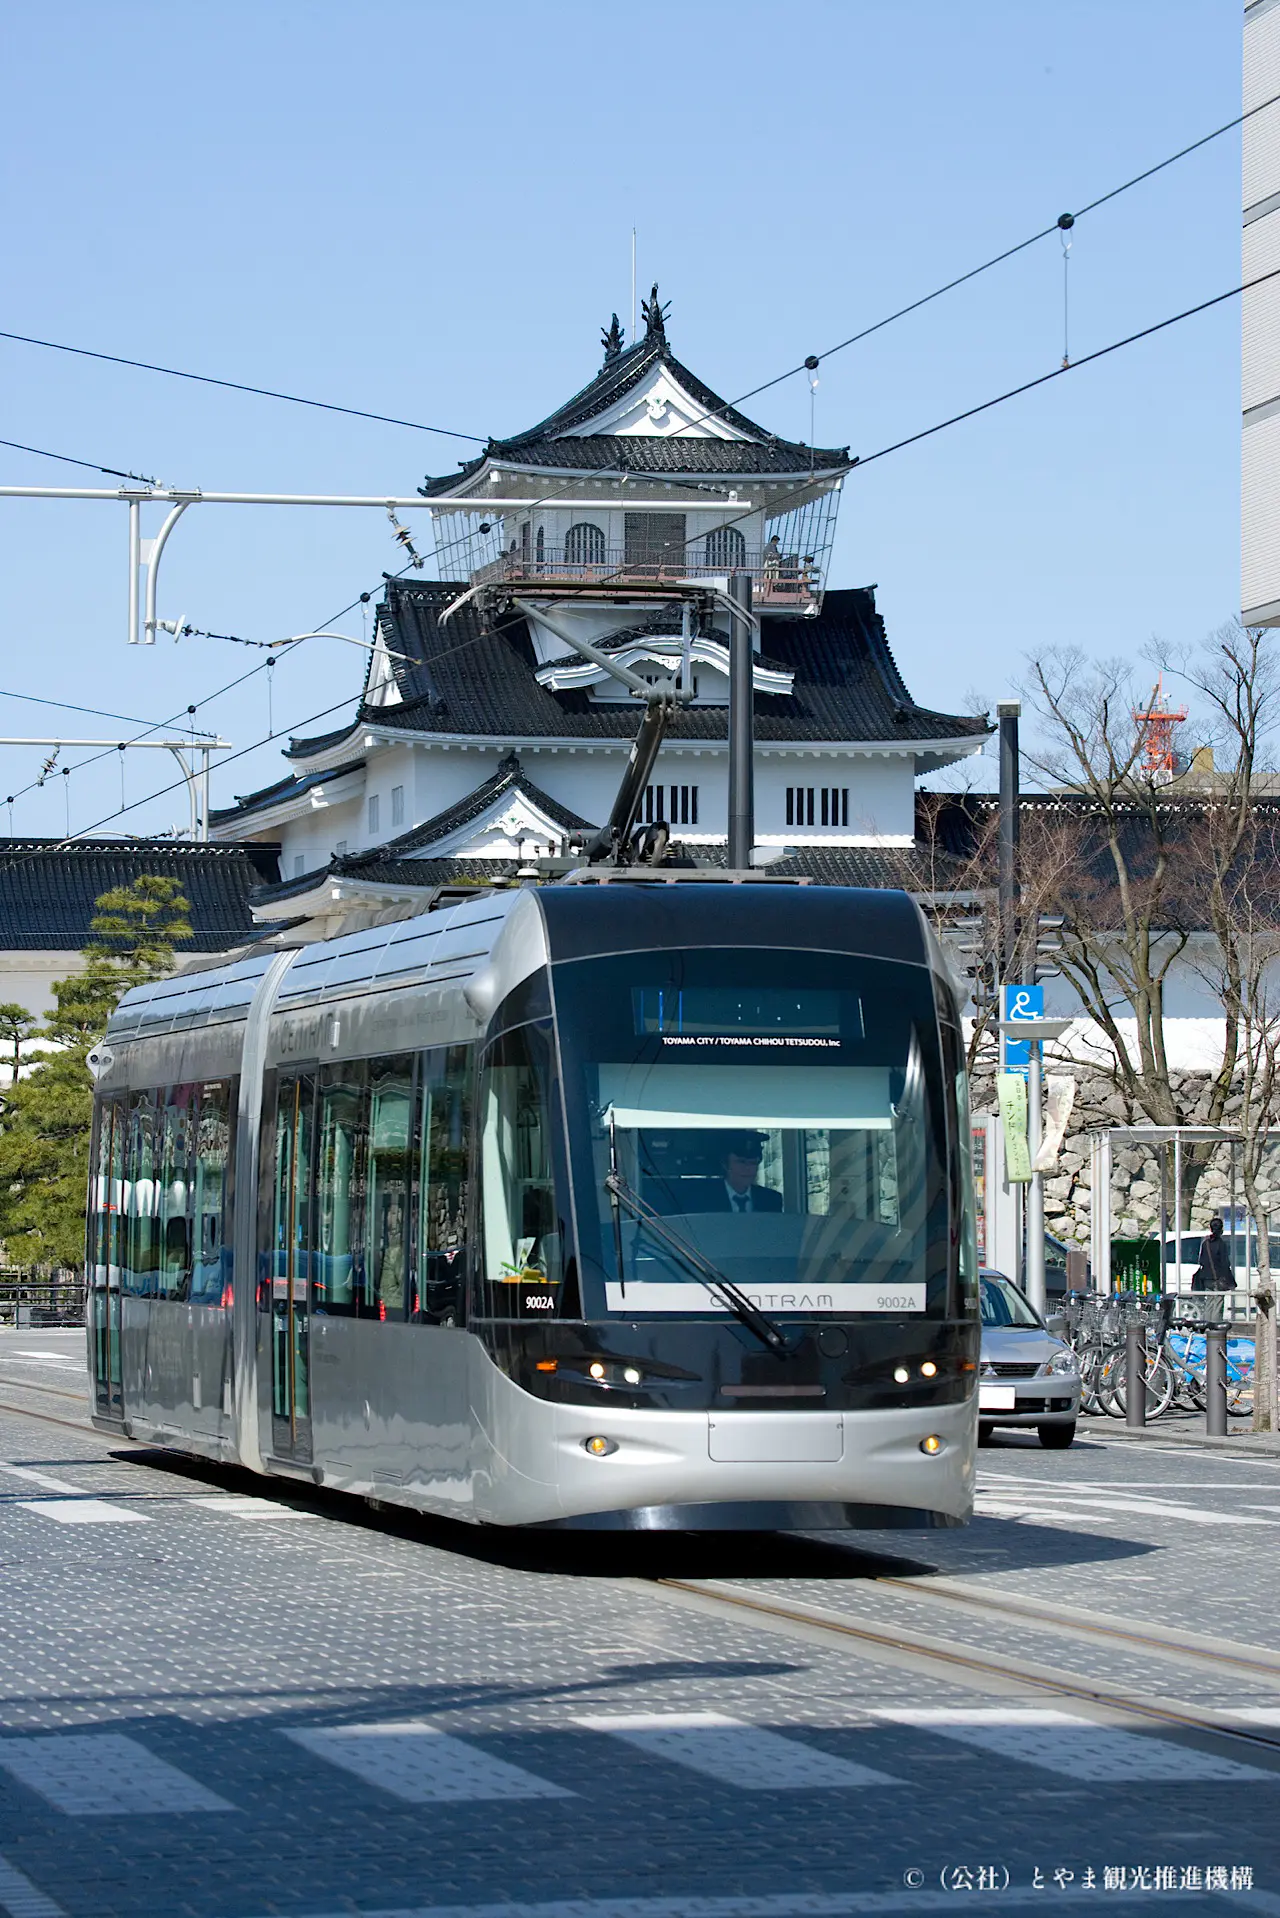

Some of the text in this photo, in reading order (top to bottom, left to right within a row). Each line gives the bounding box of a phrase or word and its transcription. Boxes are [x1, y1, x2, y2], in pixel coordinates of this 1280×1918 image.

[662, 1037, 696, 1045] TOYAMA
[697, 1037, 714, 1045] CITY
[720, 1037, 752, 1046] TOYAMA
[753, 1038, 784, 1046] CHIHOU
[829, 1039, 841, 1047] Inc
[526, 1296, 555, 1309] 9002A
[877, 1297, 916, 1309] 9002A
